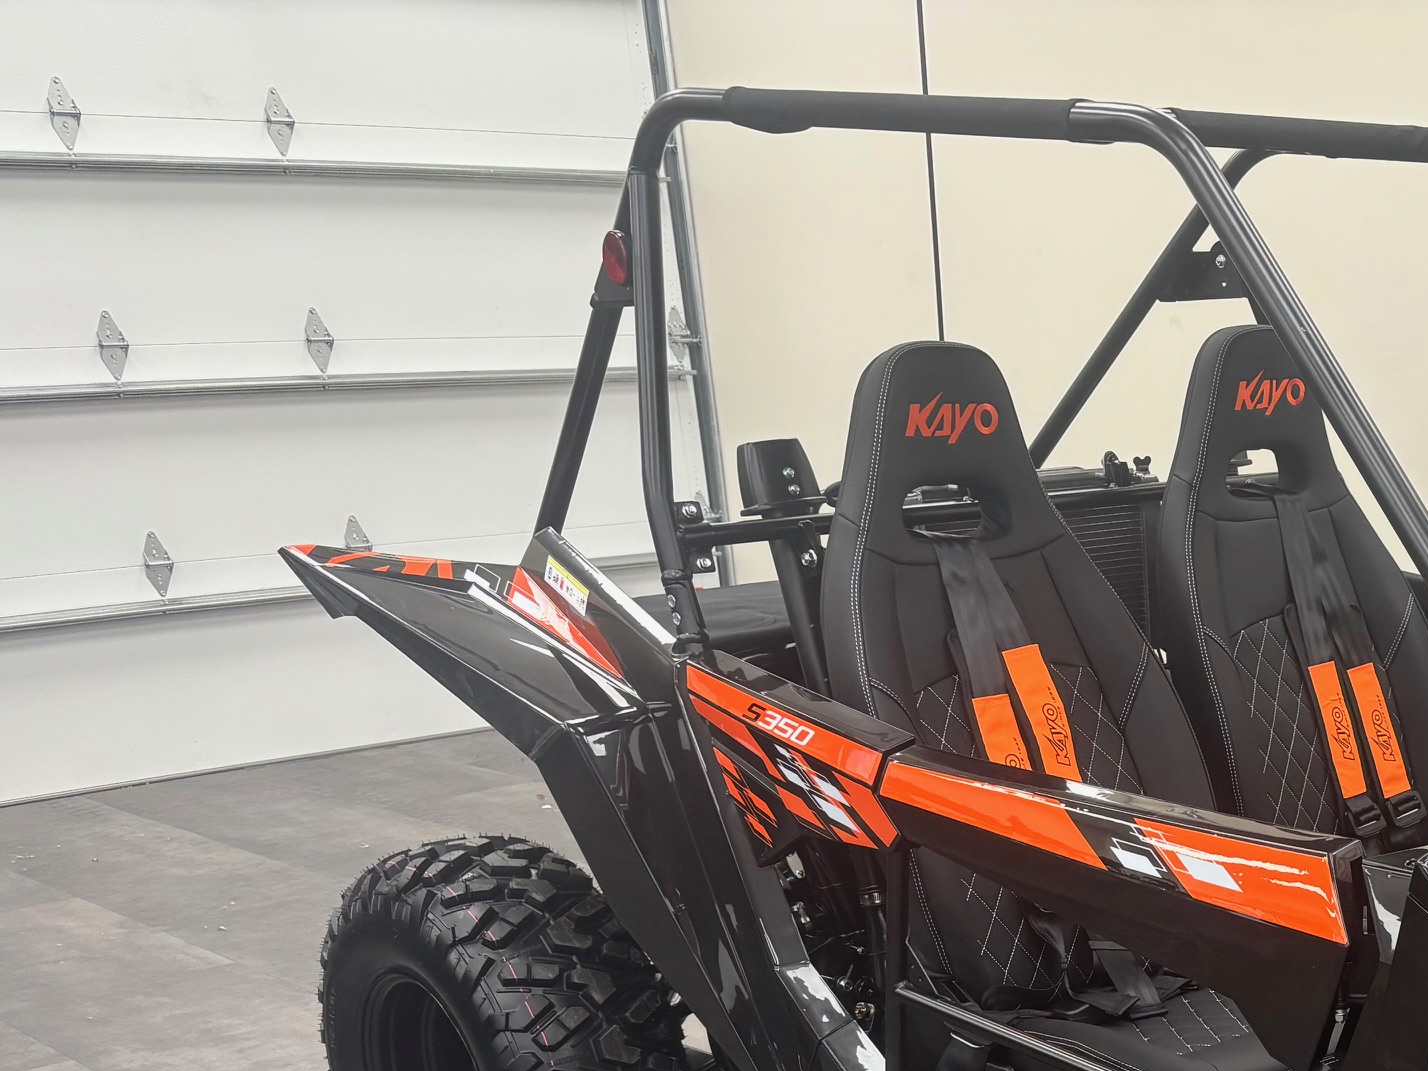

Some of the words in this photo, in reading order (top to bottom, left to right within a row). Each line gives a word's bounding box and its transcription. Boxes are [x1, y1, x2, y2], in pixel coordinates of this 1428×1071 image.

[904, 391, 999, 444] KAYO
[1234, 369, 1306, 416] KAYO
[742, 702, 816, 747] S350
[1041, 702, 1072, 767] KAYO
[1330, 706, 1356, 761] KAYO
[1369, 709, 1397, 762] KAYO
